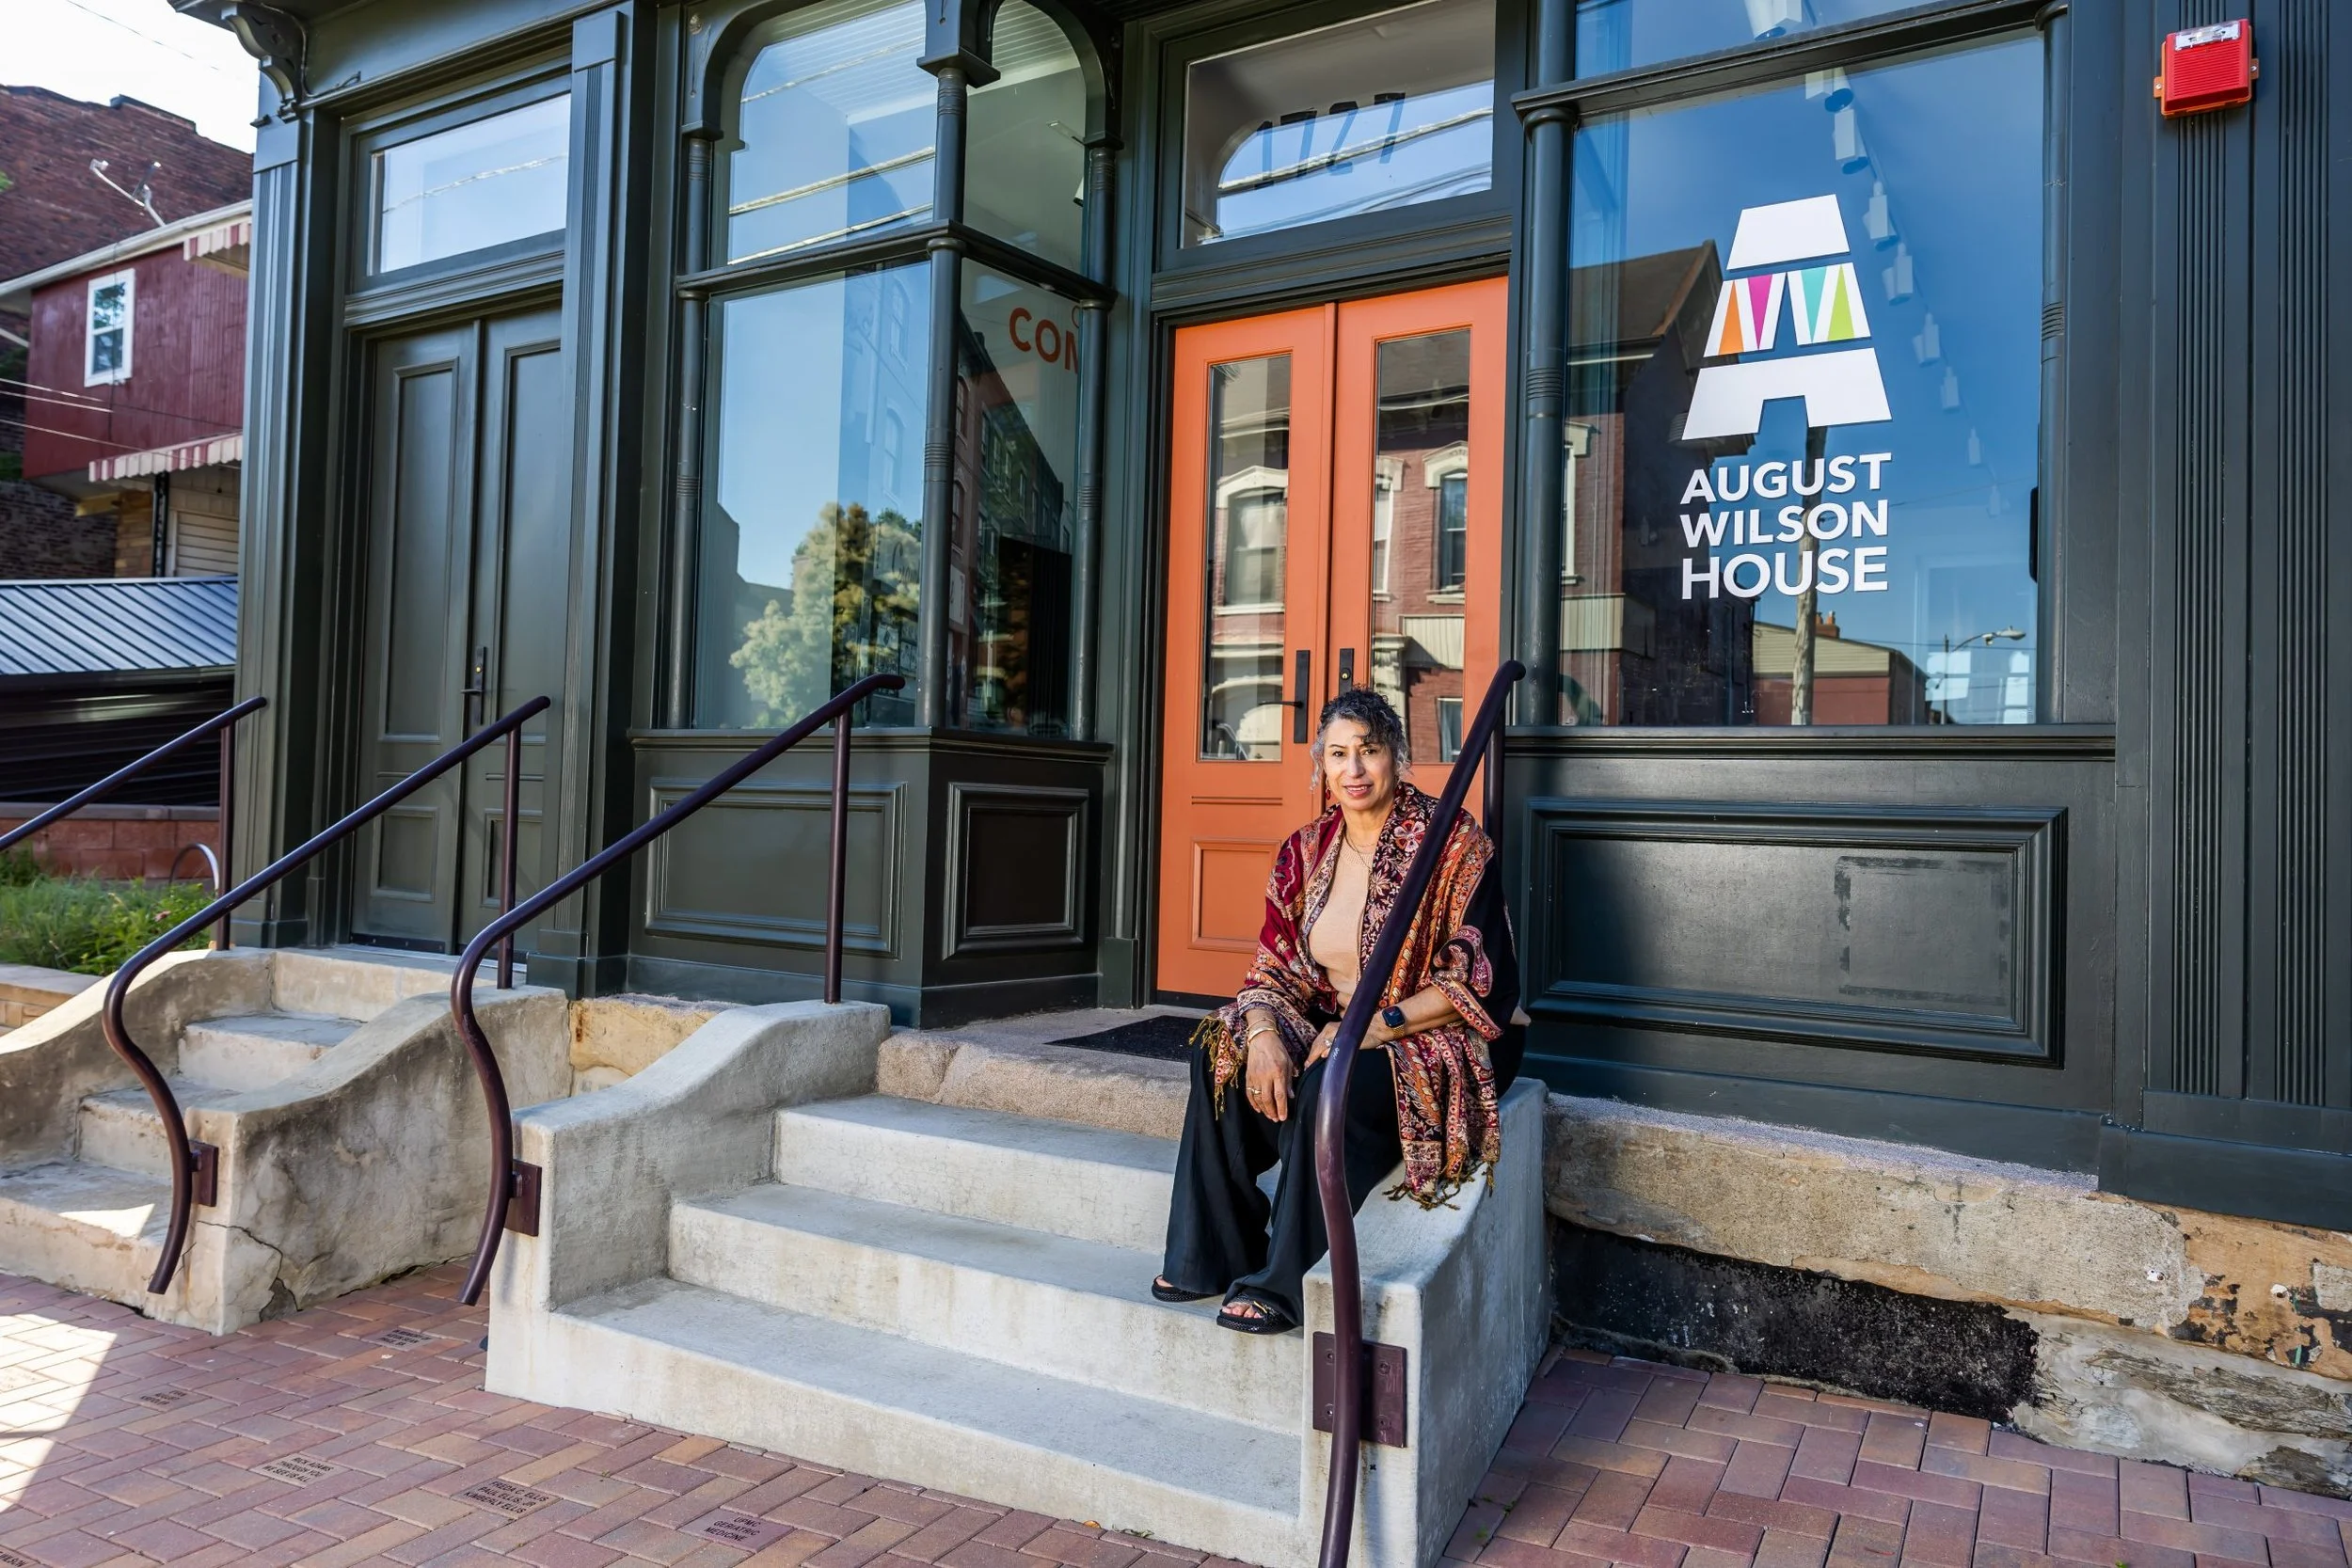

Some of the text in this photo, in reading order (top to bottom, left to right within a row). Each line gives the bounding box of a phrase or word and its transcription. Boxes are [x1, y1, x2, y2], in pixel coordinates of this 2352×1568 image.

[1254, 91, 1406, 191] 1727
[1679, 452, 1892, 504] AUGUST
[1679, 499, 1890, 548] WILSON
[1681, 546, 1889, 600] HOUSE
[478, 1487, 499, 1496] PAUL
[489, 1481, 516, 1493] FREDA
[524, 1491, 550, 1502] ELLIS
[463, 1492, 527, 1513] KIMBERLY ELLIS
[713, 1520, 760, 1536] GERIATRIC
[734, 1516, 761, 1528] UPMC
[704, 1527, 748, 1542] MEDICINE
